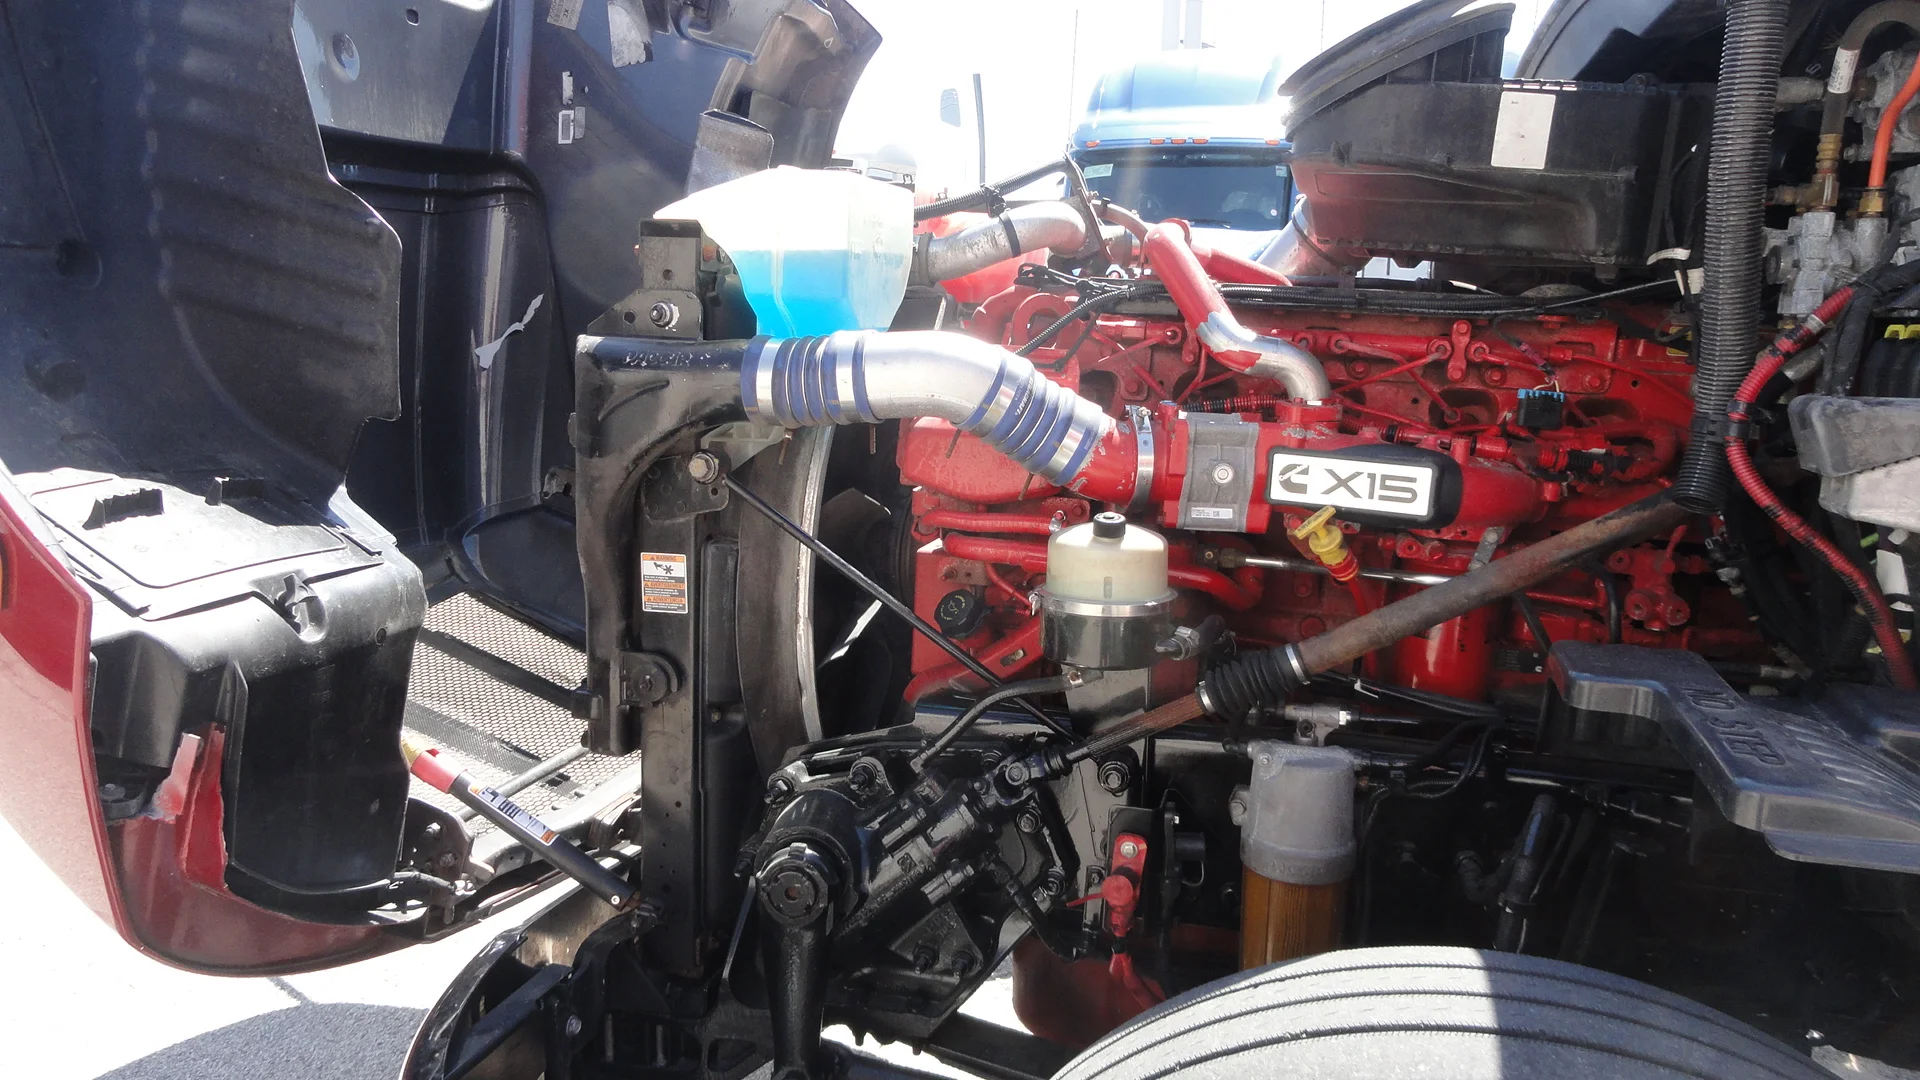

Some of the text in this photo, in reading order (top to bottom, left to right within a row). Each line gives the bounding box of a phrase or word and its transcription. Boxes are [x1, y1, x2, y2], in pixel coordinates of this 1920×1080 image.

[1320, 468, 1418, 504] X15
[1681, 687, 1786, 767] NO STEP
